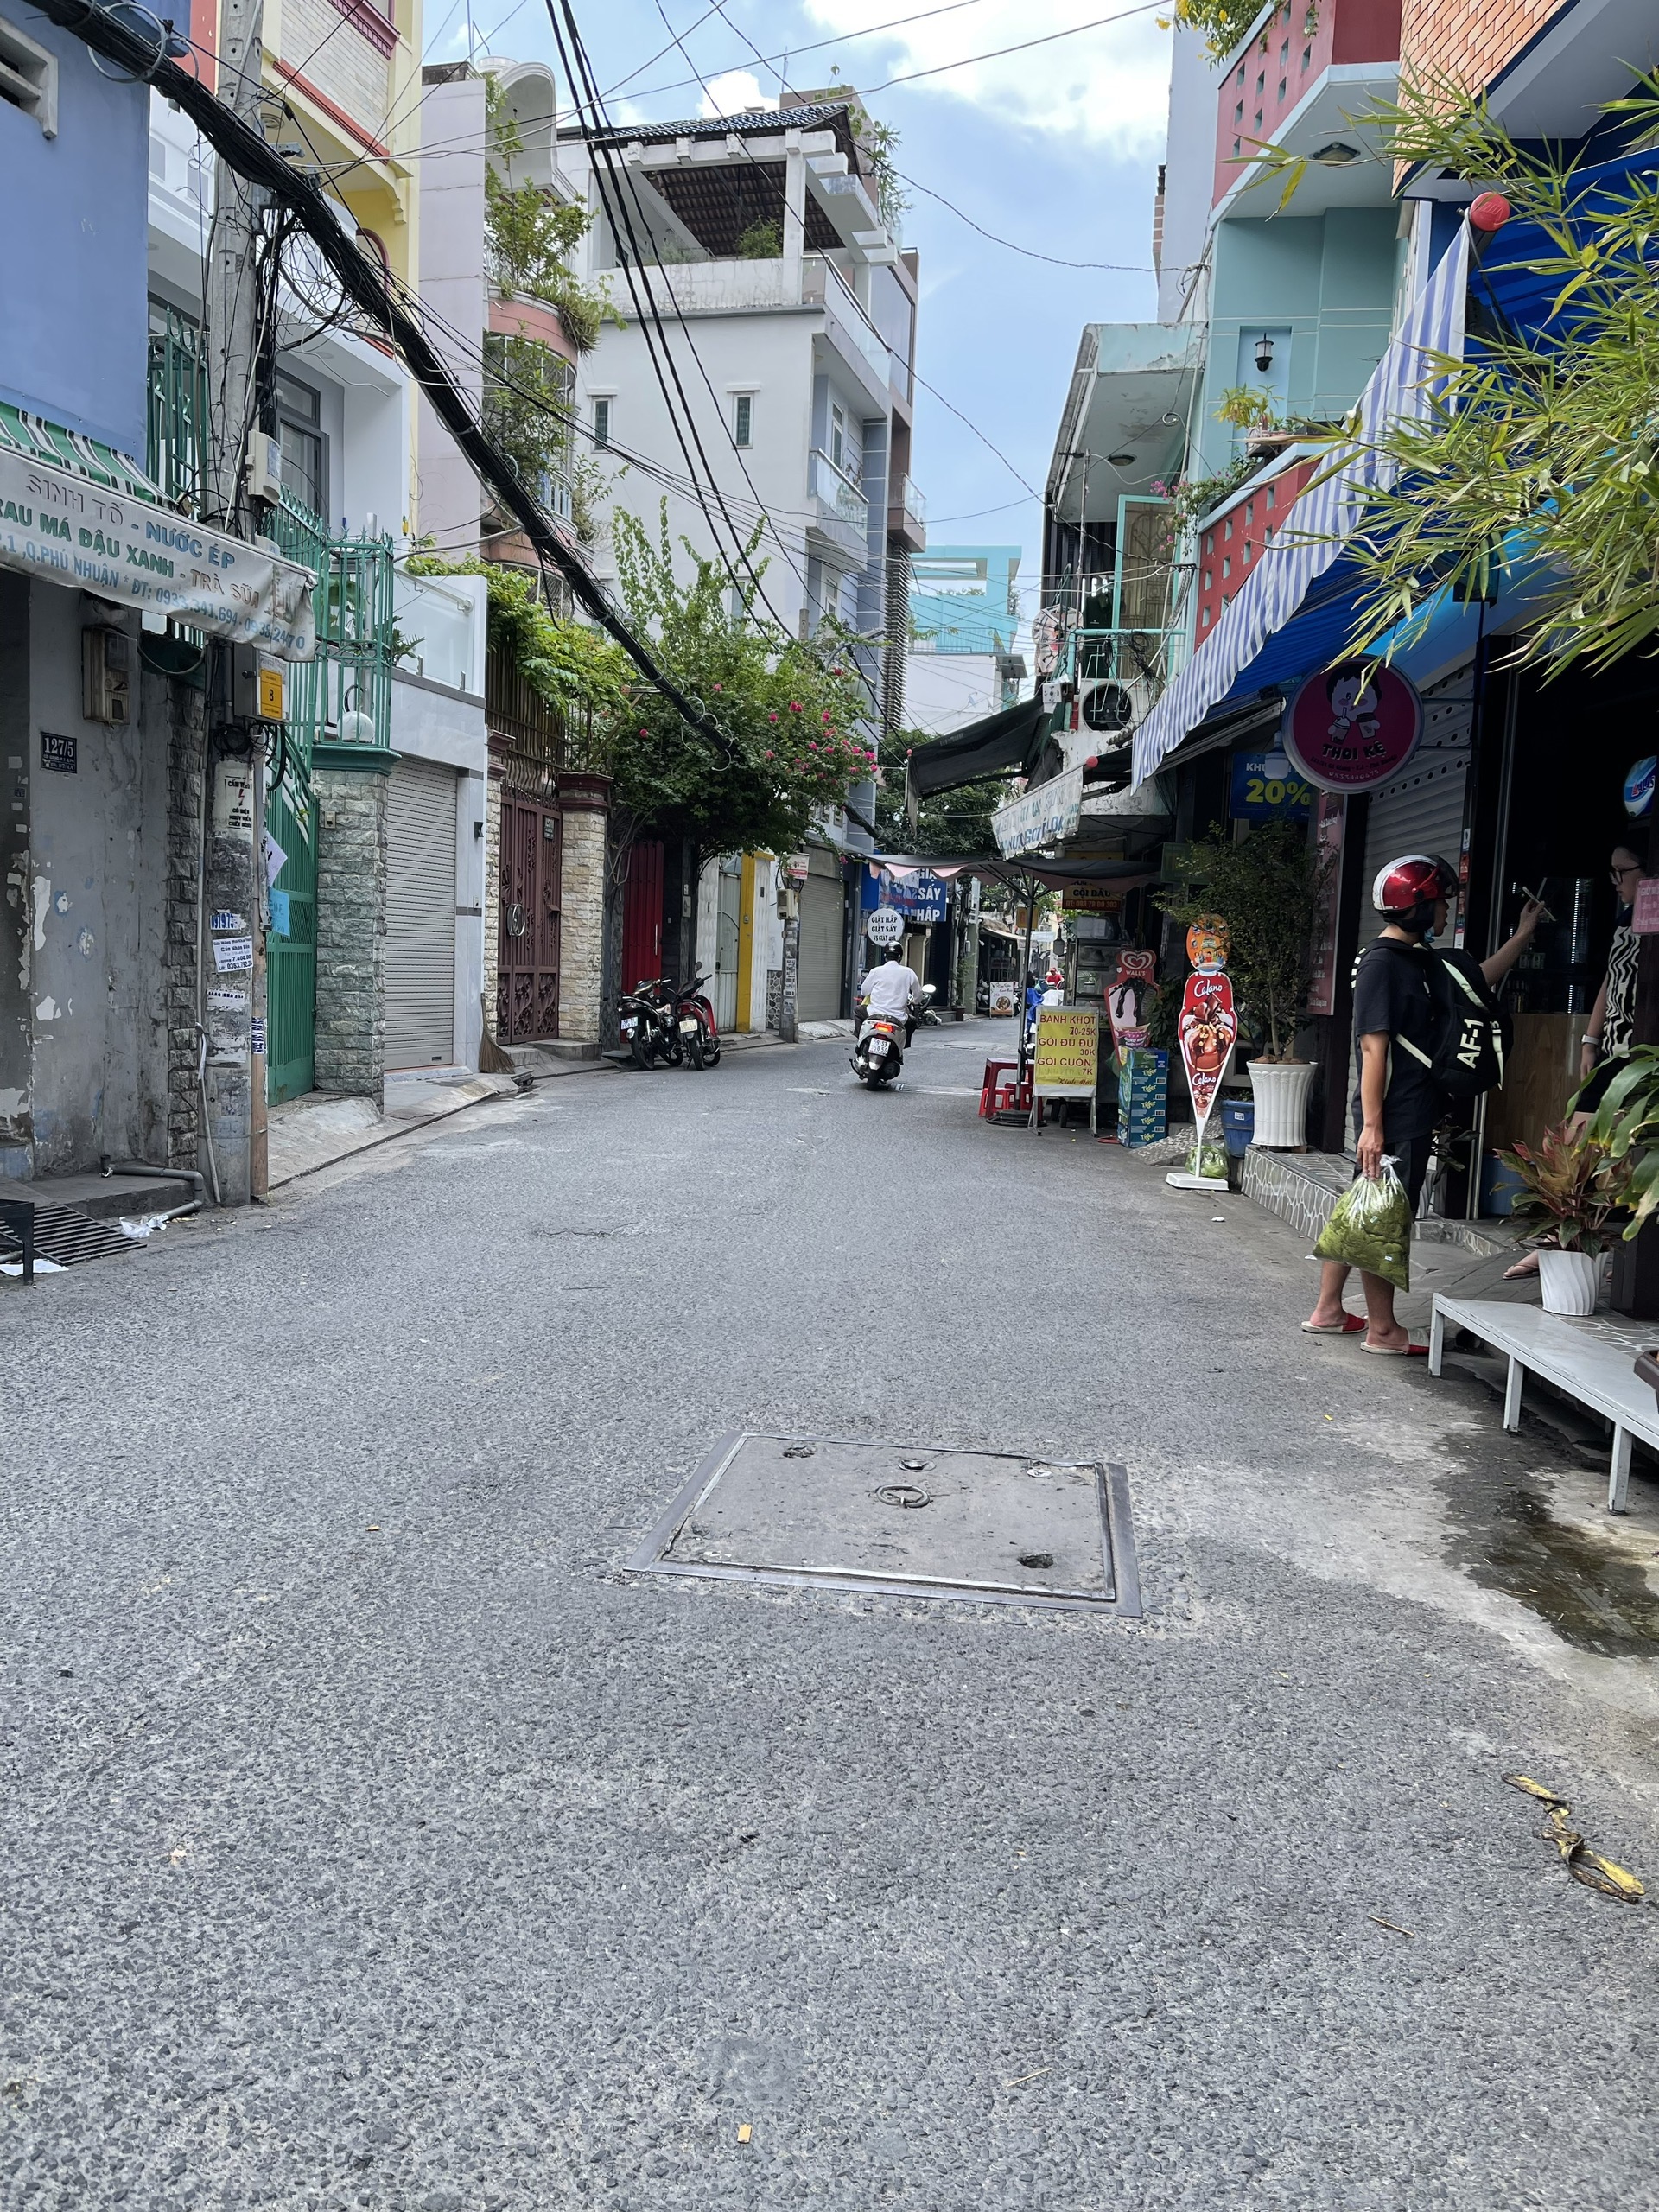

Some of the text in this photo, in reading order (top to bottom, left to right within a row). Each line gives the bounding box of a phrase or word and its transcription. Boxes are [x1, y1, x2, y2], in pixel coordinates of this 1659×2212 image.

[26, 474, 84, 512] SINH
[146, 520, 203, 558] NƯỚC
[208, 543, 236, 569] ÉP
[0, 498, 33, 527] AU
[40, 512, 72, 542] MÁ
[78, 528, 120, 559] ĐẬU
[126, 544, 174, 578] XANH
[190, 569, 226, 595] TRÀ
[73, 554, 119, 588] NHUẬN
[269, 688, 274, 702] 8
[44, 737, 74, 758] 127/5
[1245, 779, 1313, 806] 20%
[918, 883, 941, 900] SẤY
[916, 905, 940, 922] HẤP
[1193, 979, 1223, 998] Celano
[1456, 1018, 1484, 1070] AF-1
[1141, 1068, 1157, 1077] Tiger
[1192, 1072, 1217, 1087] Celano
[1141, 1084, 1157, 1093] Tiger
[1141, 1100, 1156, 1109] Tiger
[1140, 1116, 1156, 1125] Tiger
[1139, 1133, 1155, 1141] Tiger
